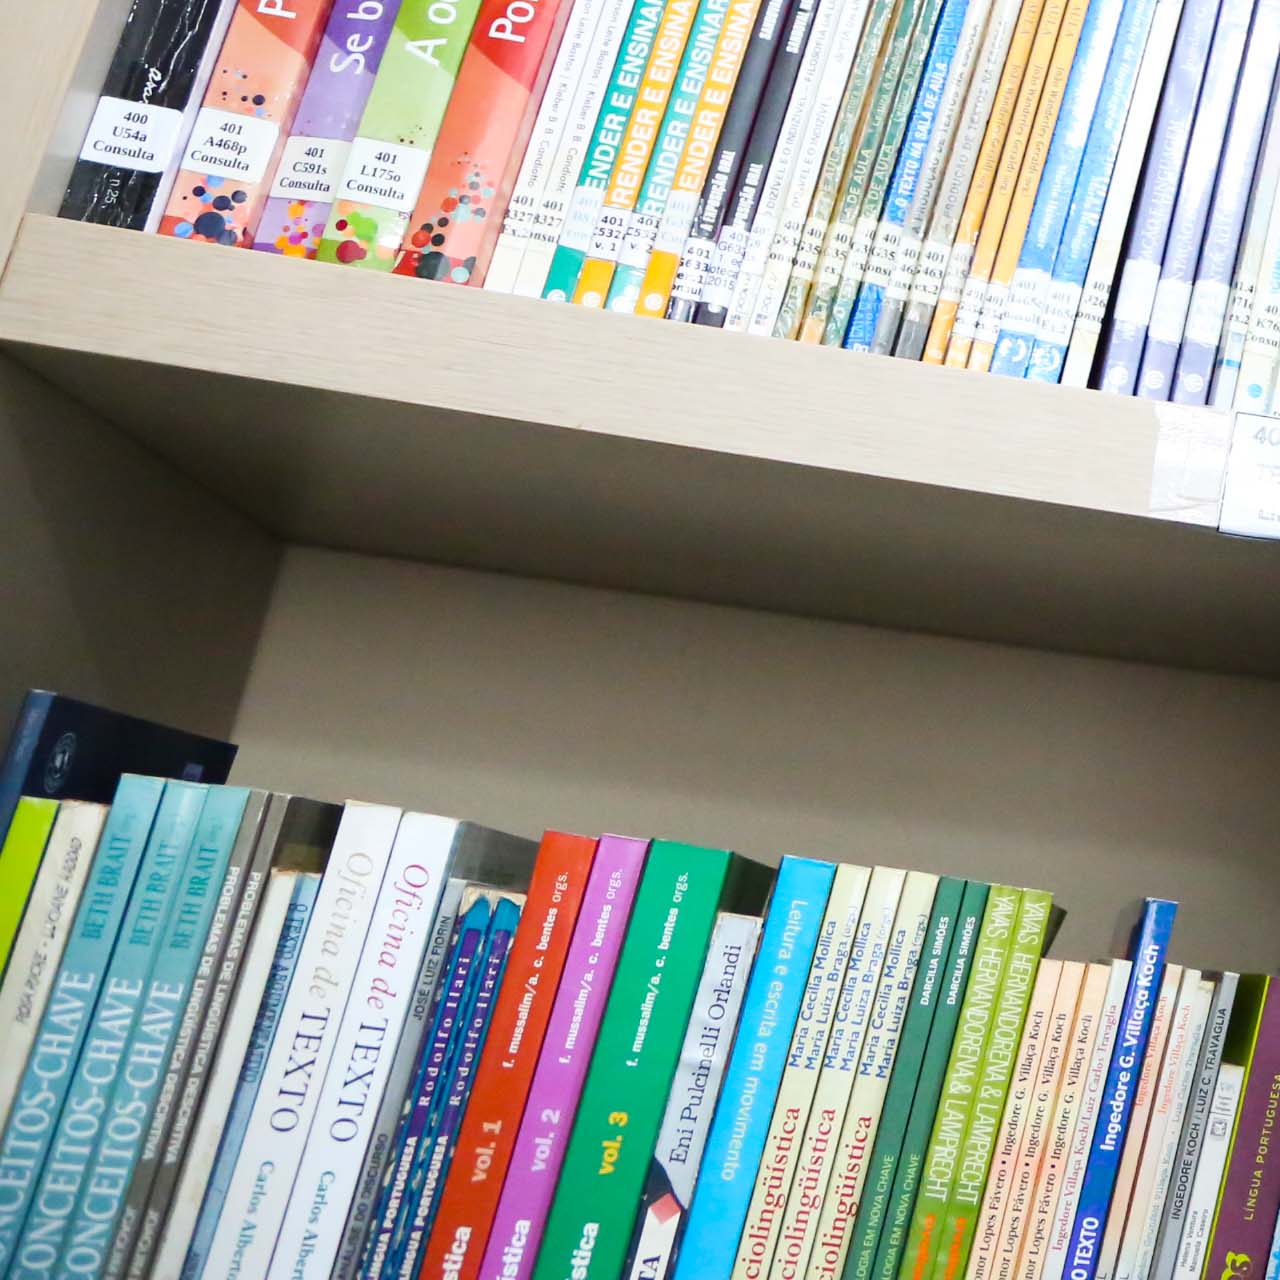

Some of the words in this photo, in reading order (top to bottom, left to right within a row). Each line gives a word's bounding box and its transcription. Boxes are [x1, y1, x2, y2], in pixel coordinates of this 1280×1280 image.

[329, 34, 372, 74] Se
[404, 38, 447, 67] A
[112, 124, 148, 143] U54a
[123, 111, 149, 125] 400
[218, 122, 243, 136] 401
[93, 139, 154, 162] Consulta
[202, 134, 247, 155] A468p
[303, 146, 325, 159] 401
[374, 151, 398, 165] 401
[587, 110, 626, 191] ENDER
[610, 88, 632, 108] E
[190, 149, 250, 172] Consulta
[293, 161, 328, 176] C591s
[359, 164, 401, 182] L175o
[279, 176, 331, 193] Consulta
[346, 178, 406, 201] Consulta
[379, 864, 429, 968] Oficina
[658, 908, 678, 951] bentes
[673, 872, 689, 904] orgs.
[779, 900, 807, 961] Leitura
[431, 916, 450, 956] FIORIN
[425, 959, 438, 990] LUIZ
[774, 965, 788, 976] e
[920, 958, 941, 1005] DARCILIA
[933, 916, 949, 955] SIMÕES
[1137, 944, 1160, 986] Koch
[367, 977, 396, 1009] de
[708, 945, 742, 1021] Orlandi
[790, 1027, 809, 1068] Maria
[814, 921, 837, 969] Mollica
[413, 992, 429, 1020] JOSÉ
[757, 982, 783, 1037] escrita
[805, 1028, 824, 1070] Maria
[815, 986, 833, 1024] Luiza
[829, 940, 848, 982] Braga
[987, 952, 1034, 1086] HERNANDORENA
[1123, 988, 1150, 1049] Villaça
[1029, 1011, 1044, 1040] Koch
[419, 1019, 452, 1105] Rodolfo
[752, 1045, 768, 1071] em
[1019, 1045, 1036, 1083] Villaça
[1120, 1049, 1136, 1068] G.
[330, 1019, 388, 1142] TEXTO
[680, 1027, 721, 1130] Pulcinelli
[1016, 1087, 1026, 1100] G.
[609, 1111, 628, 1127] 3
[722, 1077, 759, 1181] movimento
[1003, 1103, 1021, 1156] Ingedore
[1100, 1068, 1131, 1151] Ingedore
[1172, 1160, 1191, 1220] INGEDORE
[1187, 1122, 1199, 1158] KOCH
[1198, 1093, 1209, 1116] LUIZ
[1204, 1008, 1227, 1071] TRAVAGLIA
[598, 1135, 623, 1175] vol.
[669, 1129, 694, 1164] Eni
[957, 1103, 997, 1205] LAMPRECHT
[247, 1161, 274, 1214] Carlos
[744, 1108, 800, 1280] ciolingüística
[990, 1169, 1008, 1211] Fávero
[981, 1214, 997, 1249] Lopes
